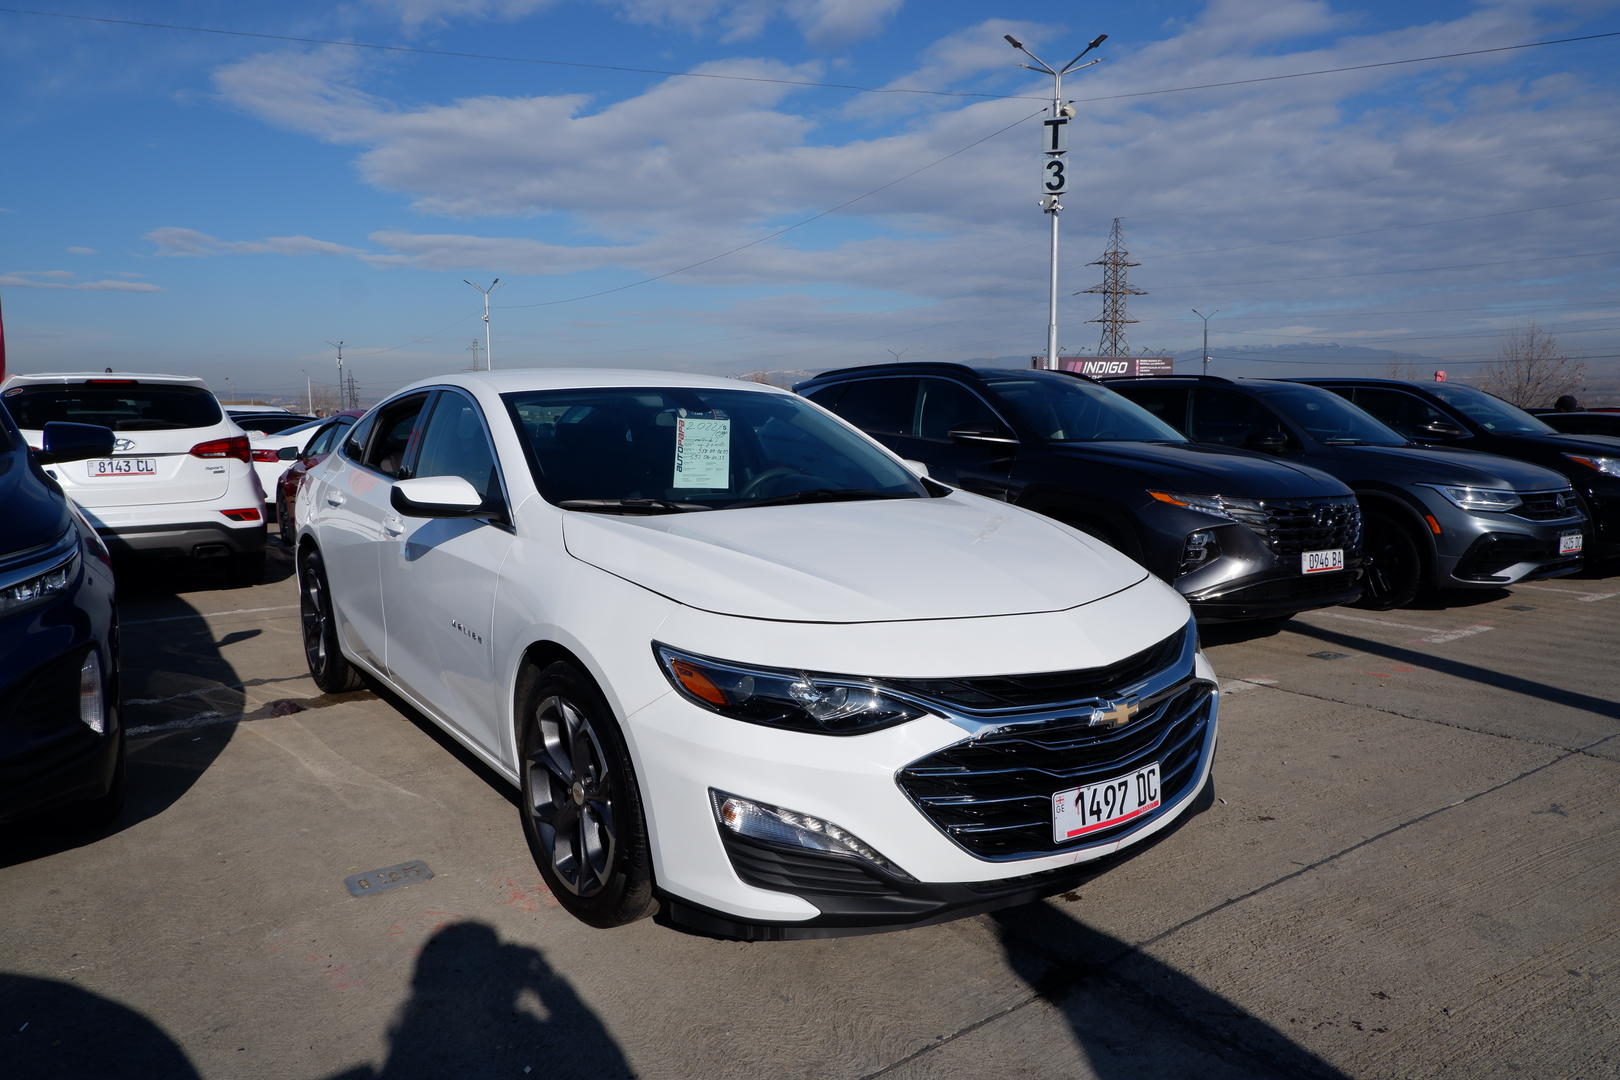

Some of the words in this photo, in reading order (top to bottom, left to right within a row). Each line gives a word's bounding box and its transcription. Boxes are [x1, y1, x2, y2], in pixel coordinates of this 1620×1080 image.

[1043, 118, 1068, 150] T
[1045, 160, 1066, 191] 3
[1082, 361, 1128, 374] INDIGO
[98, 461, 131, 473] 8143
[136, 460, 153, 472] CL
[1309, 552, 1329, 569] 0946
[1332, 551, 1342, 567] BA
[1075, 780, 1128, 826] 1497
[1136, 768, 1157, 807] DC
